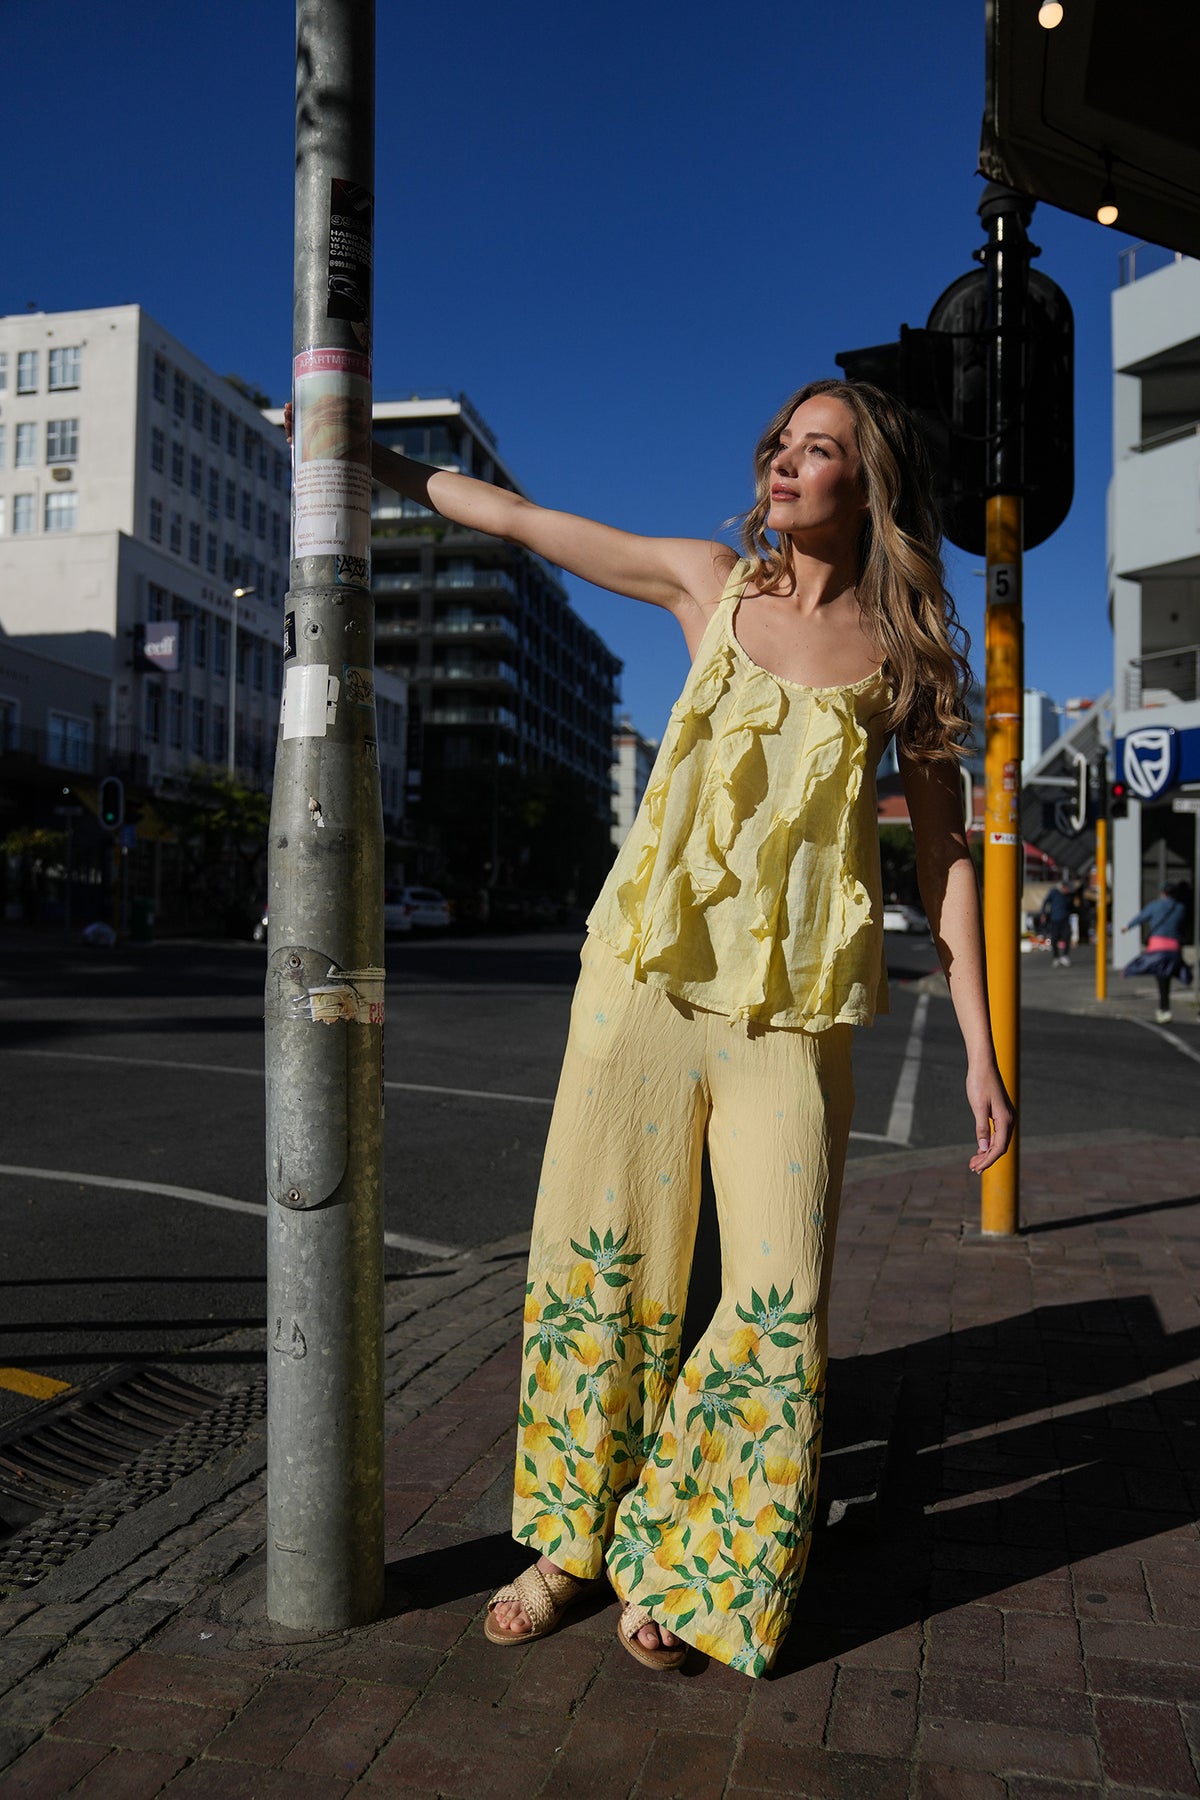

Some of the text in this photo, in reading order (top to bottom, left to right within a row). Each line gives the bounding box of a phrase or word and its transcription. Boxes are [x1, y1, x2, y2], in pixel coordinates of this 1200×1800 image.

[330, 229, 359, 241] HARD
[329, 249, 357, 260] CAPE
[996, 569, 1010, 597] 5
